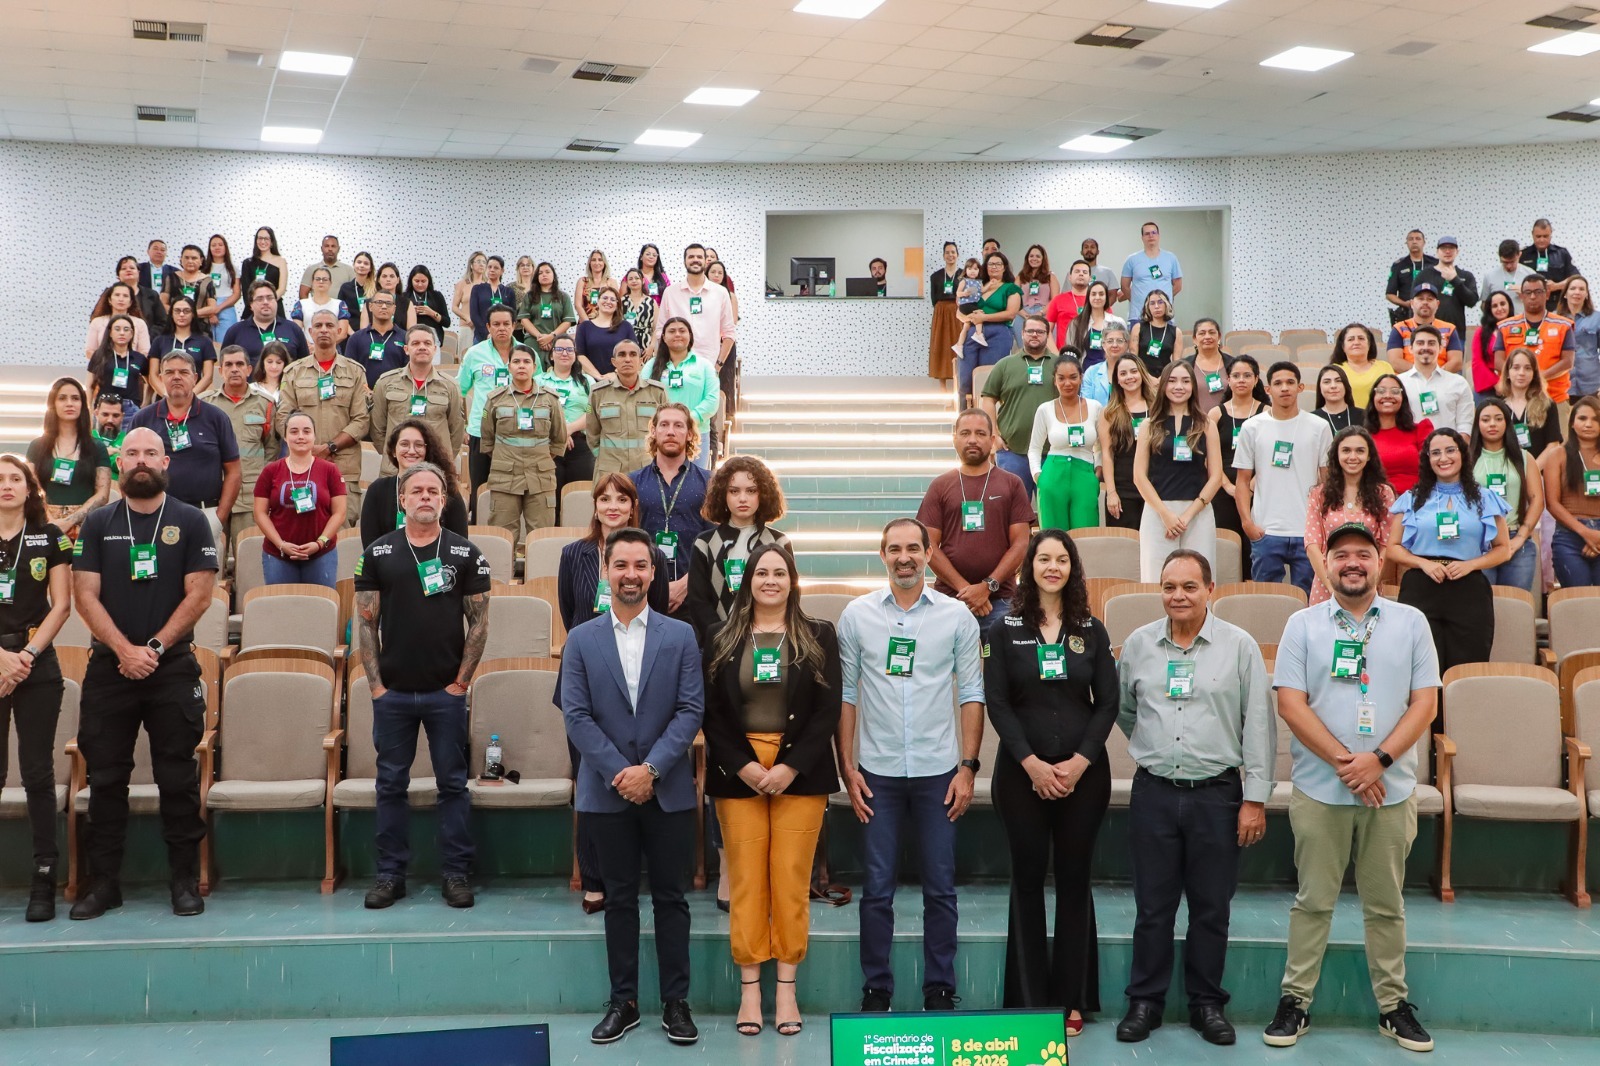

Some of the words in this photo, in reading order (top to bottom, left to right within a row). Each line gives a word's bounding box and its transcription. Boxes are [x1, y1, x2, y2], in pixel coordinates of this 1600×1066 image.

[873, 1034, 920, 1044] Seminário
[920, 1033, 934, 1042] de
[952, 1038, 962, 1052] 8
[964, 1038, 983, 1052] de
[984, 1036, 1018, 1052] abril
[864, 1043, 934, 1056] Fiscalização
[864, 1058, 882, 1066] em
[882, 1054, 920, 1066] Crimes
[920, 1054, 934, 1065] de
[952, 1054, 972, 1066] de
[973, 1054, 1008, 1066] 2026
